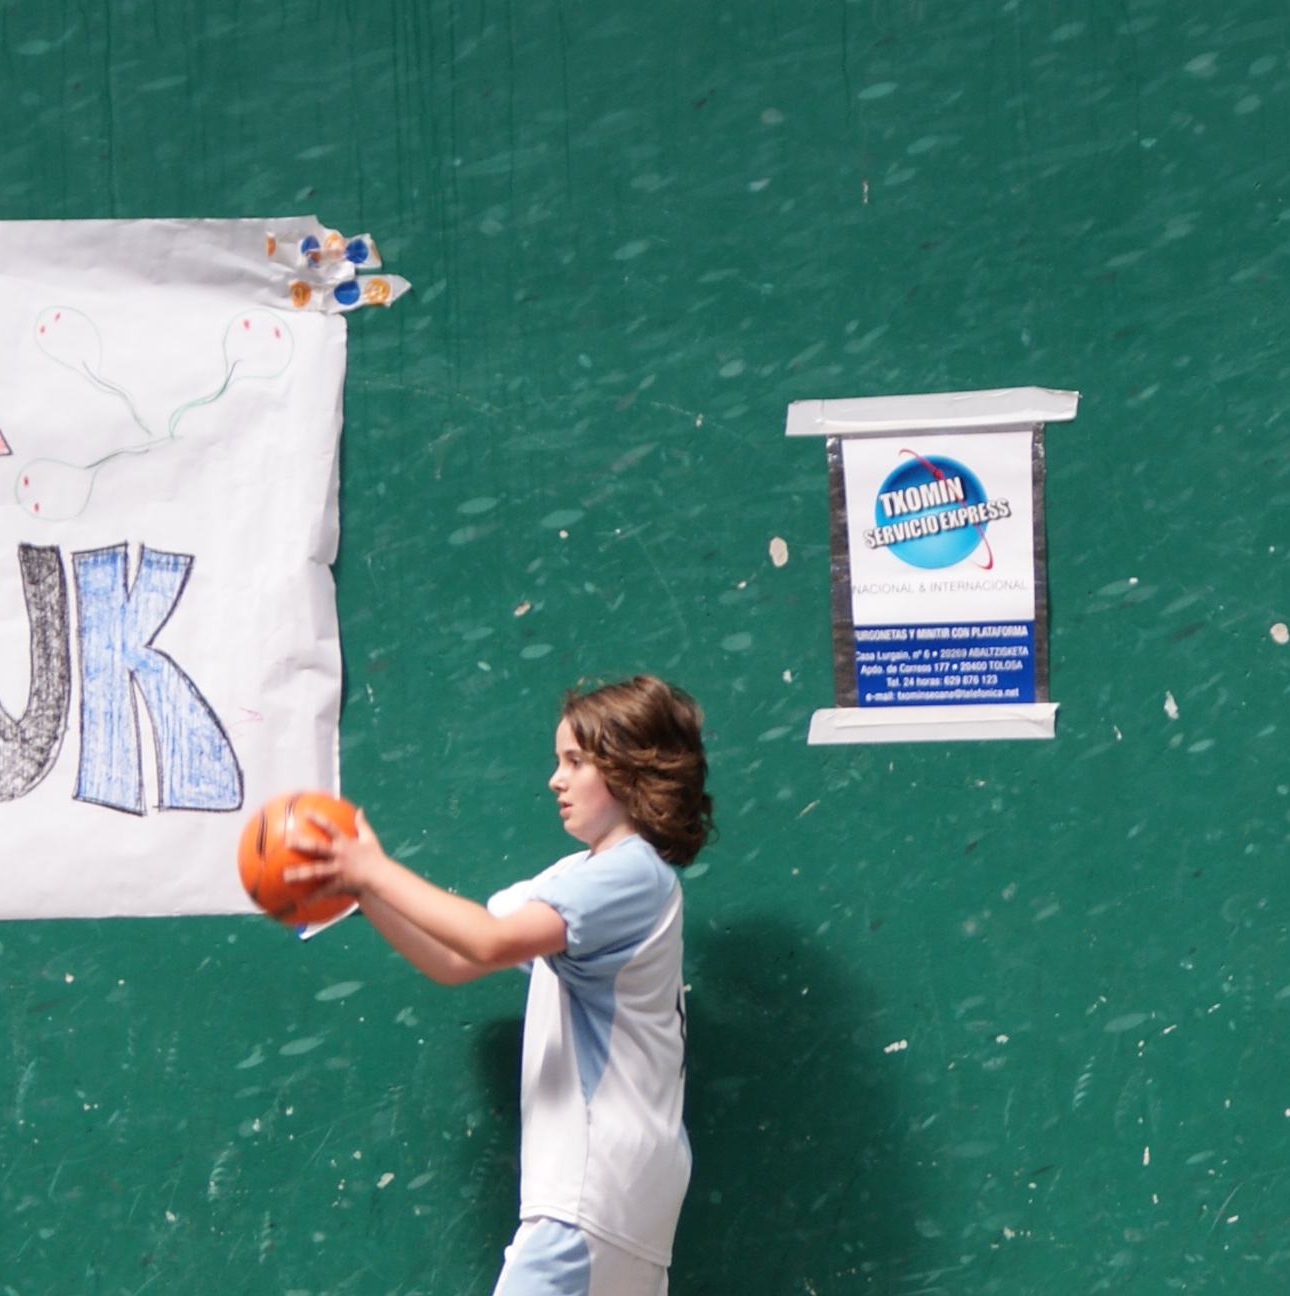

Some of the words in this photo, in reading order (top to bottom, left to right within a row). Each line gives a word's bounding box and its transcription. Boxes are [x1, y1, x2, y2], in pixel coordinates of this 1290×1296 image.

[880, 476, 965, 518] TXOMIN
[864, 515, 940, 549] SERVICIO
[940, 499, 1011, 531] EXPRESS
[853, 583, 913, 595] NACIONAL
[919, 583, 926, 593] &
[930, 580, 1027, 593] INTERNACIONAL
[855, 629, 907, 641] URGONETAS
[909, 628, 915, 639] Y
[952, 626, 970, 638] CON
[971, 625, 1028, 638] PLATAFORMA
[923, 650, 930, 659] 6
[886, 664, 897, 674] de
[934, 662, 950, 672] 177
[989, 660, 1023, 671] TOLOSA
[886, 677, 900, 687] Tel.
[903, 676, 914, 687] 24
[982, 674, 998, 684] 123
